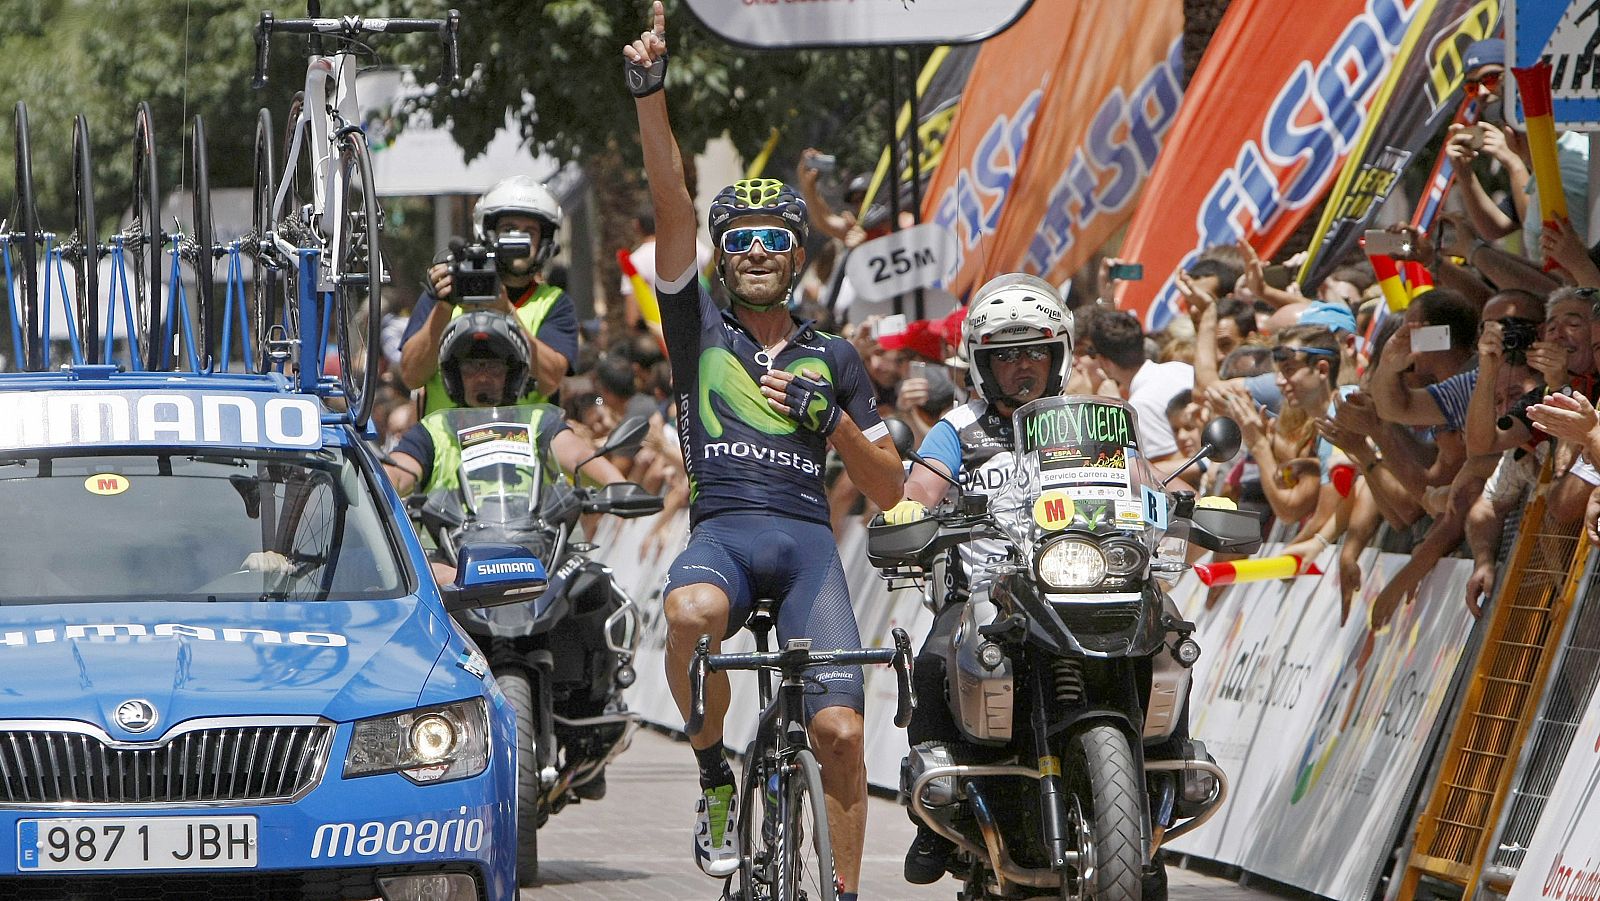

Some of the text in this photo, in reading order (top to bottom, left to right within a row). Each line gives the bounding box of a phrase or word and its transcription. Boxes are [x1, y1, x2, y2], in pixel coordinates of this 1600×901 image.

[869, 246, 936, 284] 25M
[1036, 303, 1062, 321] NOLAN
[704, 441, 822, 477] movistar
[97, 477, 119, 490] M
[1044, 470, 1126, 482] Servicio Carrera 232
[1044, 498, 1066, 523] M
[477, 562, 535, 576] SHIMANO
[24, 823, 249, 863] E 9871 JBH
[309, 806, 485, 859] macario
